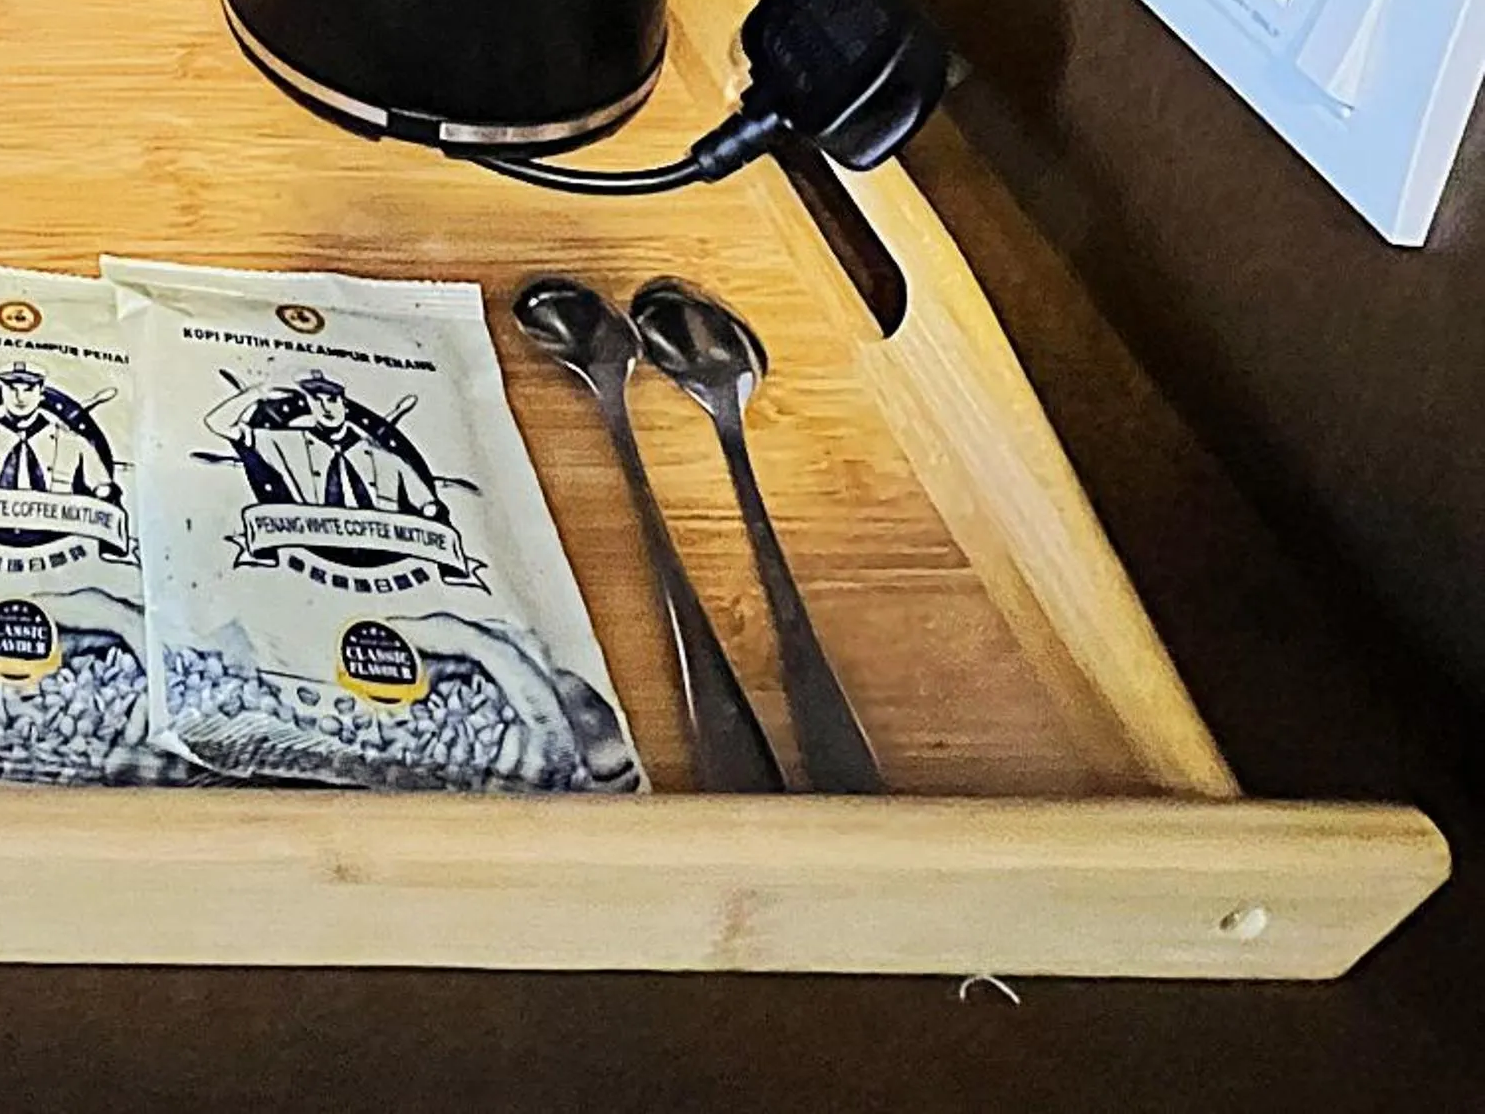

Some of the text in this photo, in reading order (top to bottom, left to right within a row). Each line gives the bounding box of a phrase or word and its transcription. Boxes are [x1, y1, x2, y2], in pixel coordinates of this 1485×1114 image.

[182, 327, 220, 342] KOPI
[223, 331, 271, 349] PUTIH
[372, 354, 437, 372] PENANG
[12, 501, 58, 519] COFFEE
[60, 504, 114, 529] MIXTURE
[253, 515, 447, 550] PENANG WHITE COFFEE MIXTURE
[345, 646, 411, 665] CLASSIC
[349, 661, 413, 680] FLAVOUR
